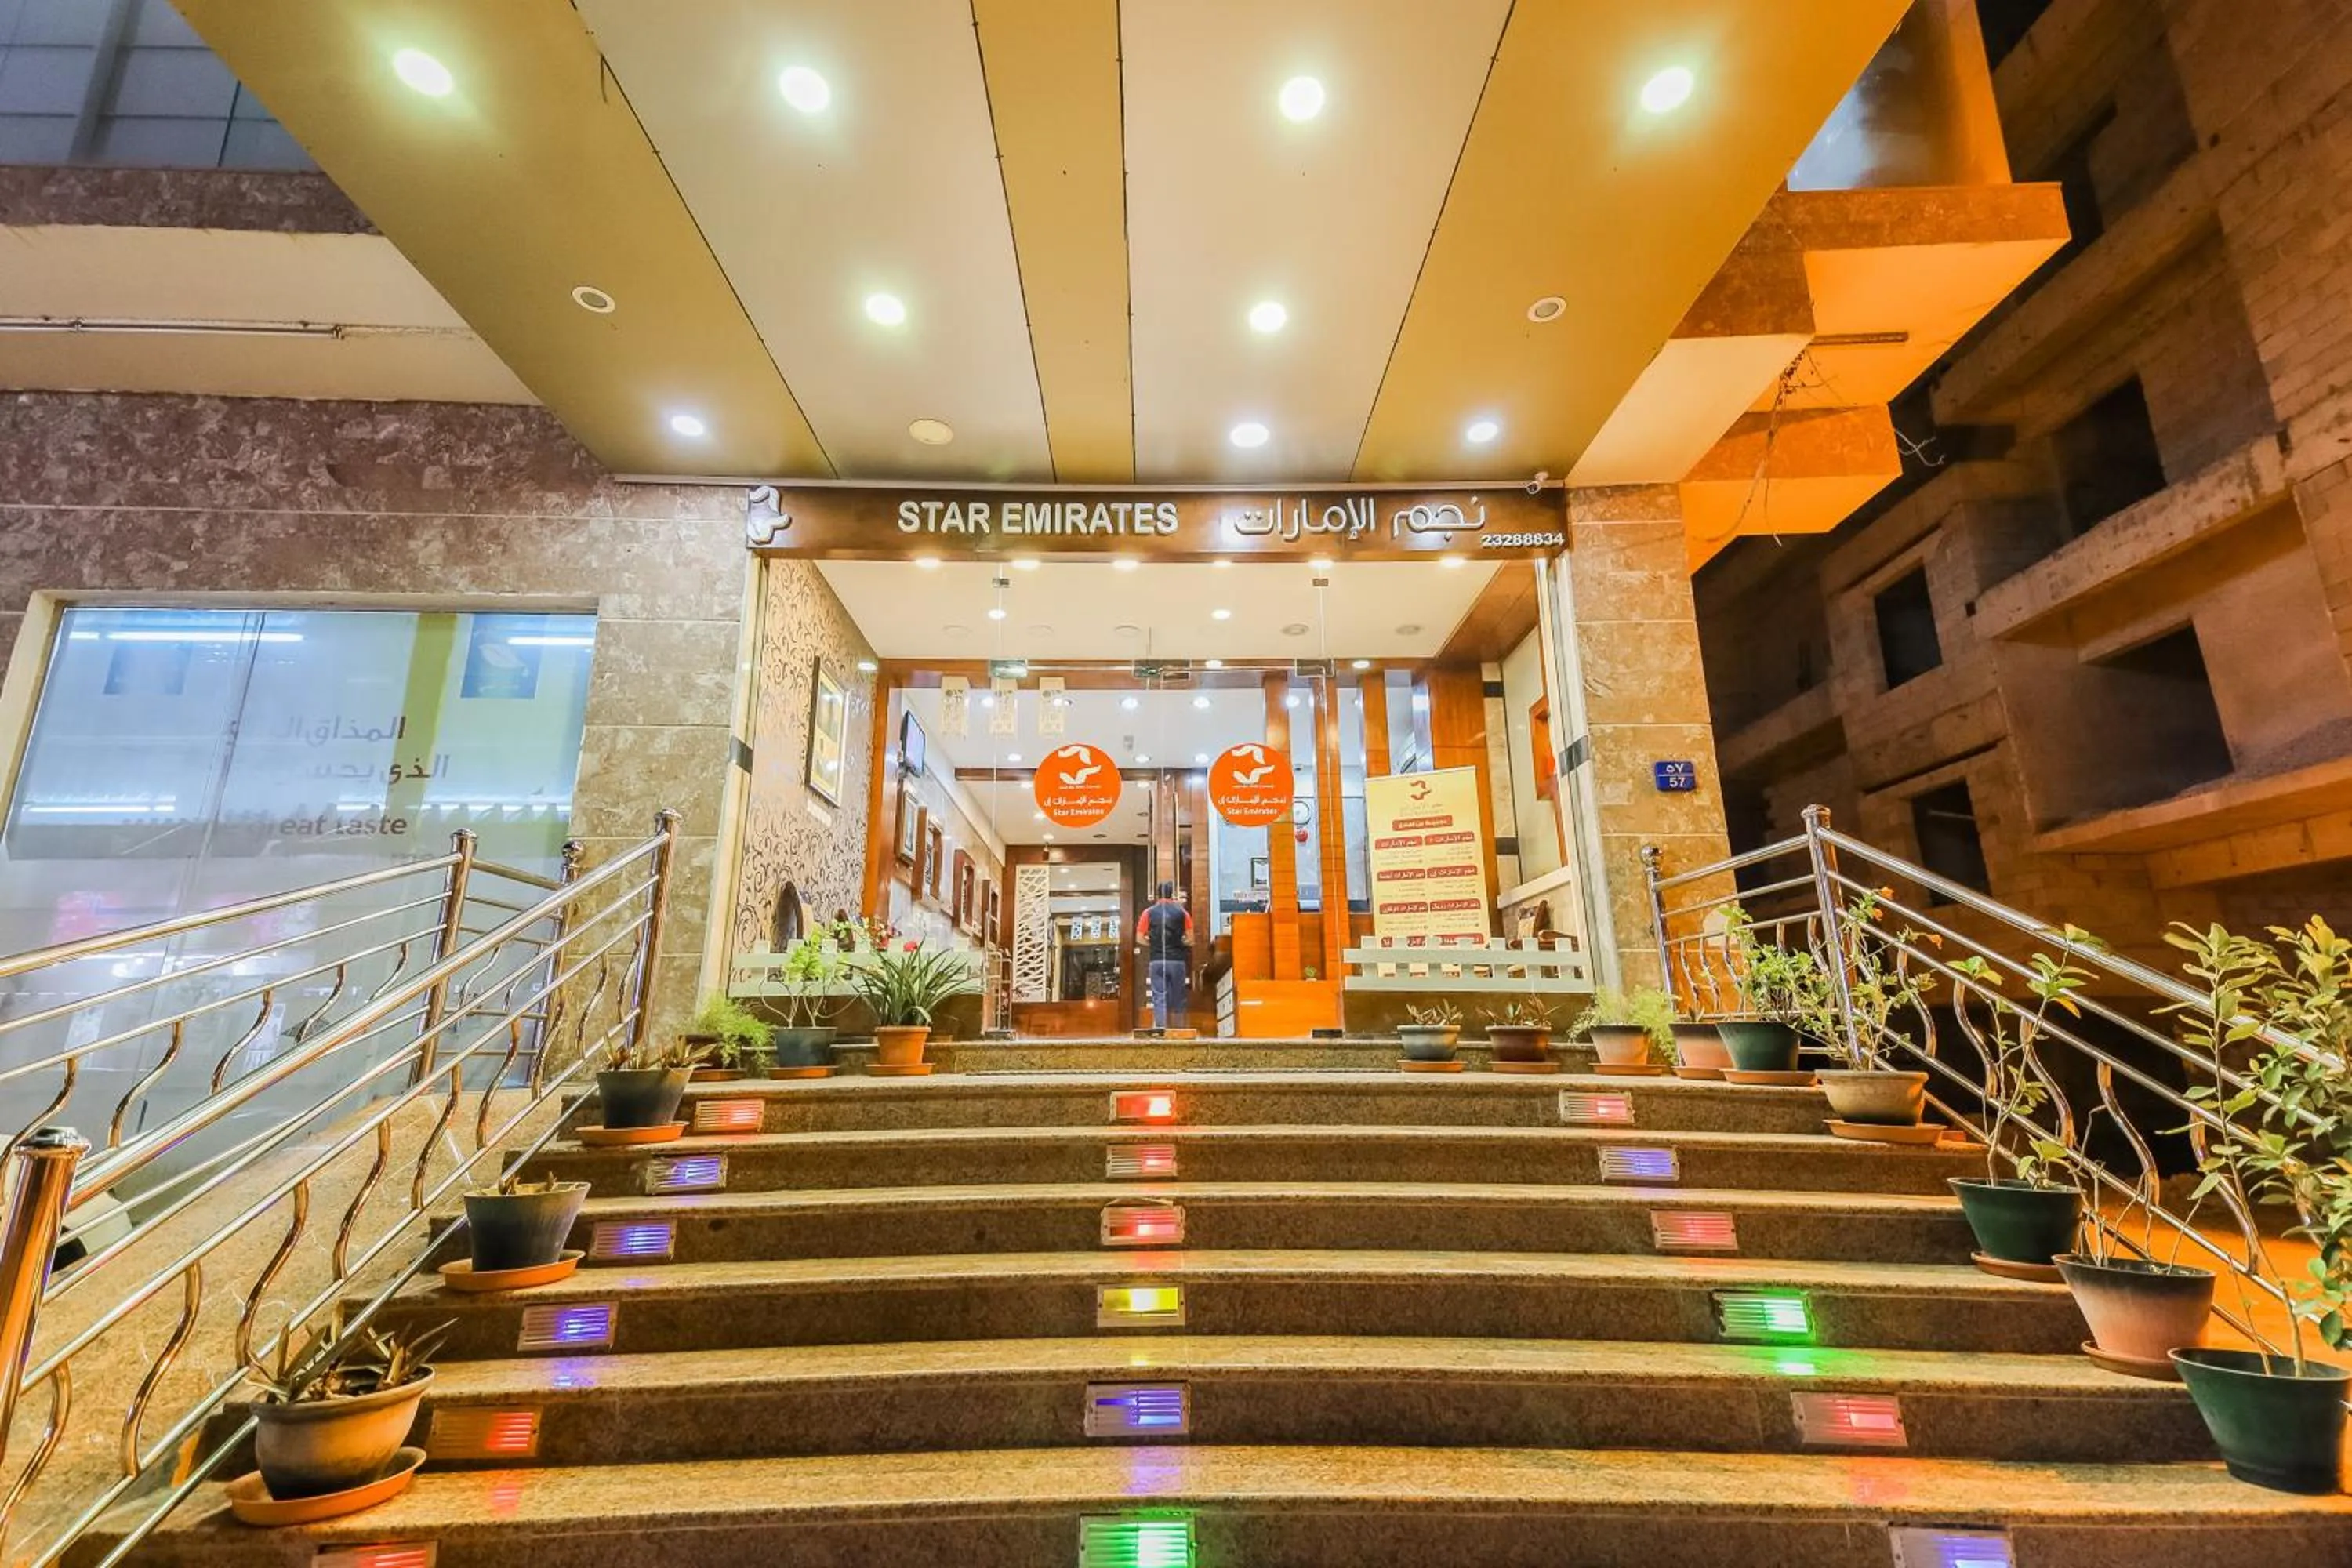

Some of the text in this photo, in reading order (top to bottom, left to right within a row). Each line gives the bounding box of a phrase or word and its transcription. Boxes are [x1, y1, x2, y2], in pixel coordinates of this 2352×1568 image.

[898, 501, 1179, 535] STAR EMIRATES
[1234, 495, 1486, 543] نجم الإمارات
[1480, 532, 1565, 548] 23288834
[1669, 777, 1686, 788] 57
[1227, 808, 1279, 816] Star Emirates
[336, 814, 408, 836] taste
